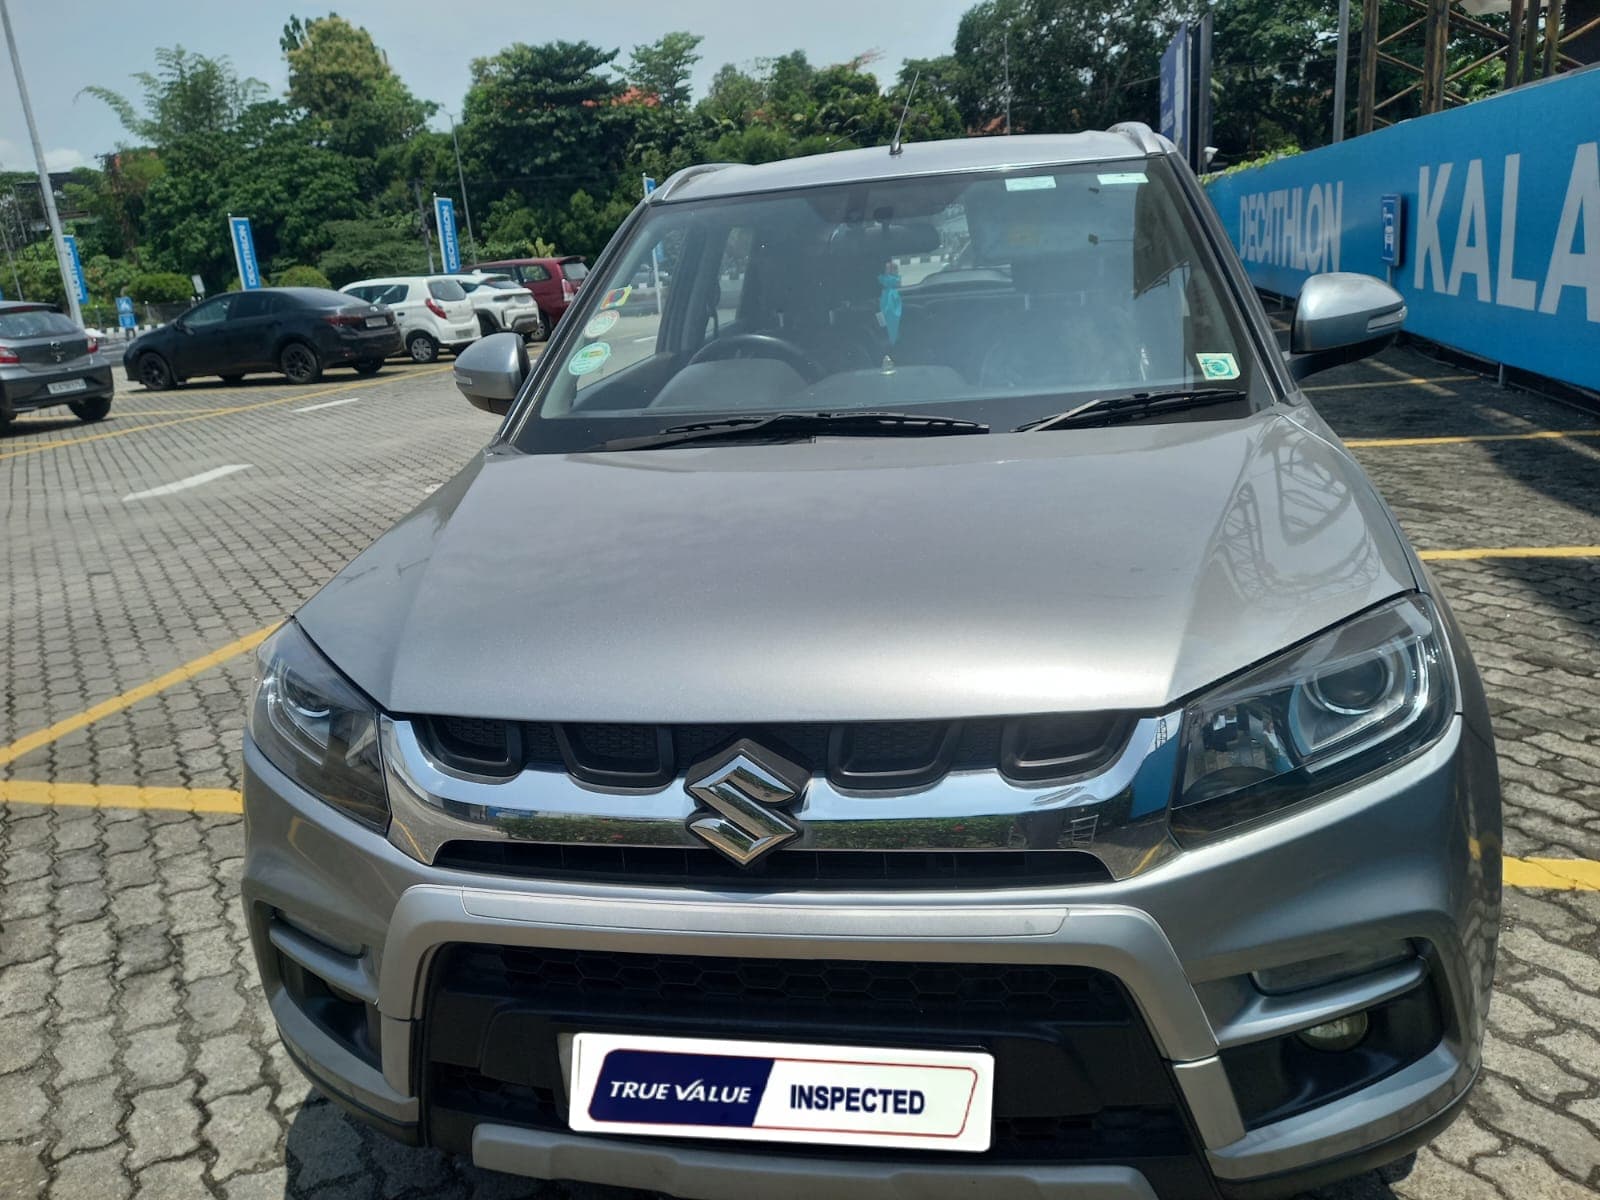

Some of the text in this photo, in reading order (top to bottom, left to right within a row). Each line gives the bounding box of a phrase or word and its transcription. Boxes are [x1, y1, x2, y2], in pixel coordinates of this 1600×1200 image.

[1239, 180, 1343, 273] DECATHLON
[1414, 141, 1600, 324] KALA
[610, 1078, 926, 1116] TRUE VALUE INSPECTED
